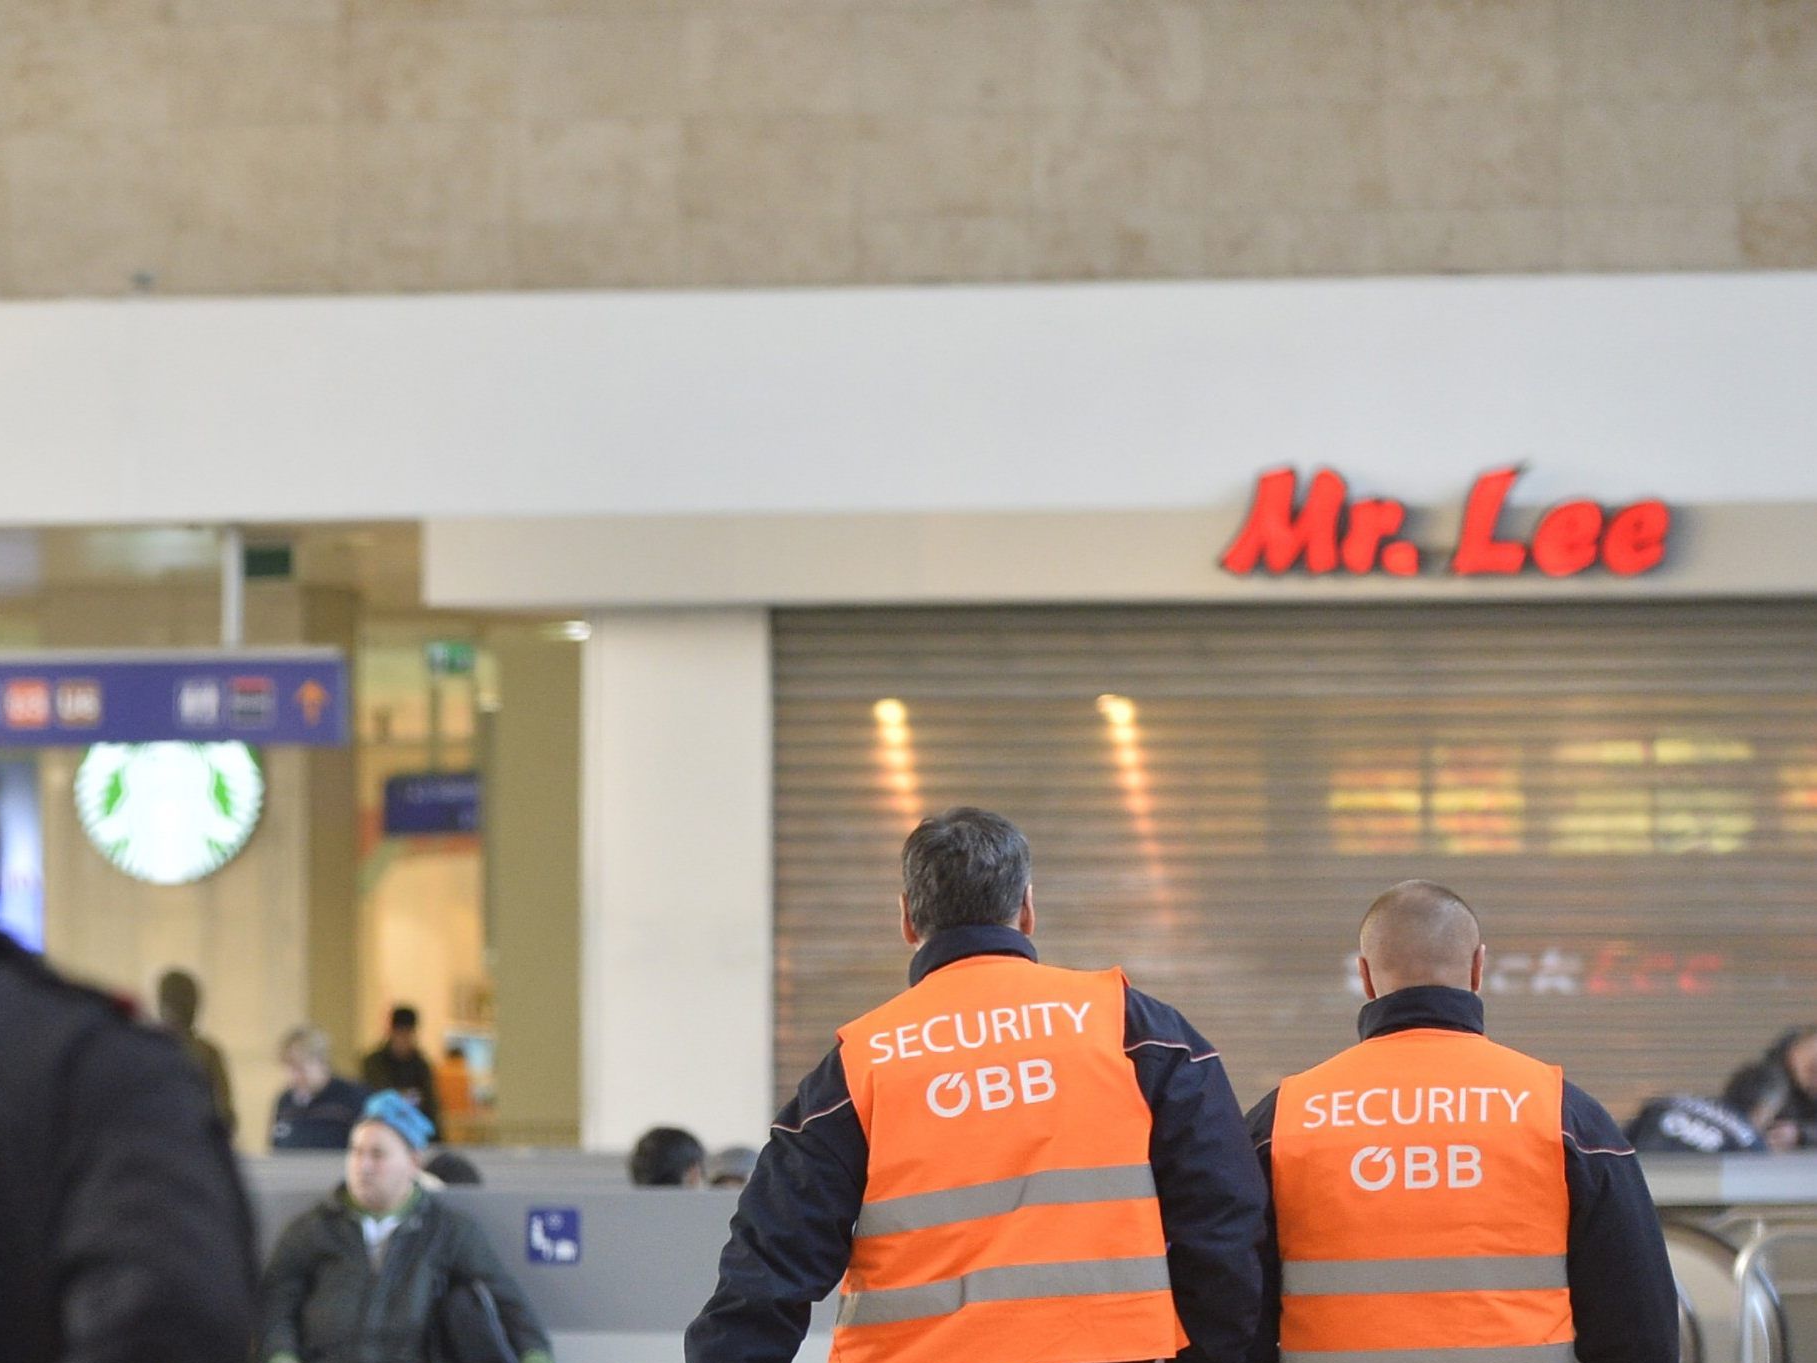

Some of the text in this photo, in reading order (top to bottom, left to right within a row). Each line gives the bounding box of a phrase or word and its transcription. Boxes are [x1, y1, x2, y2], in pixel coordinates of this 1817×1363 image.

[1222, 465, 1670, 576] Mr. Lee
[869, 1002, 1092, 1064] SECURITY
[926, 1059, 1057, 1118] ÖBB
[1302, 1086, 1531, 1129] SECURITY
[1350, 1144, 1482, 1192] ÖBB
